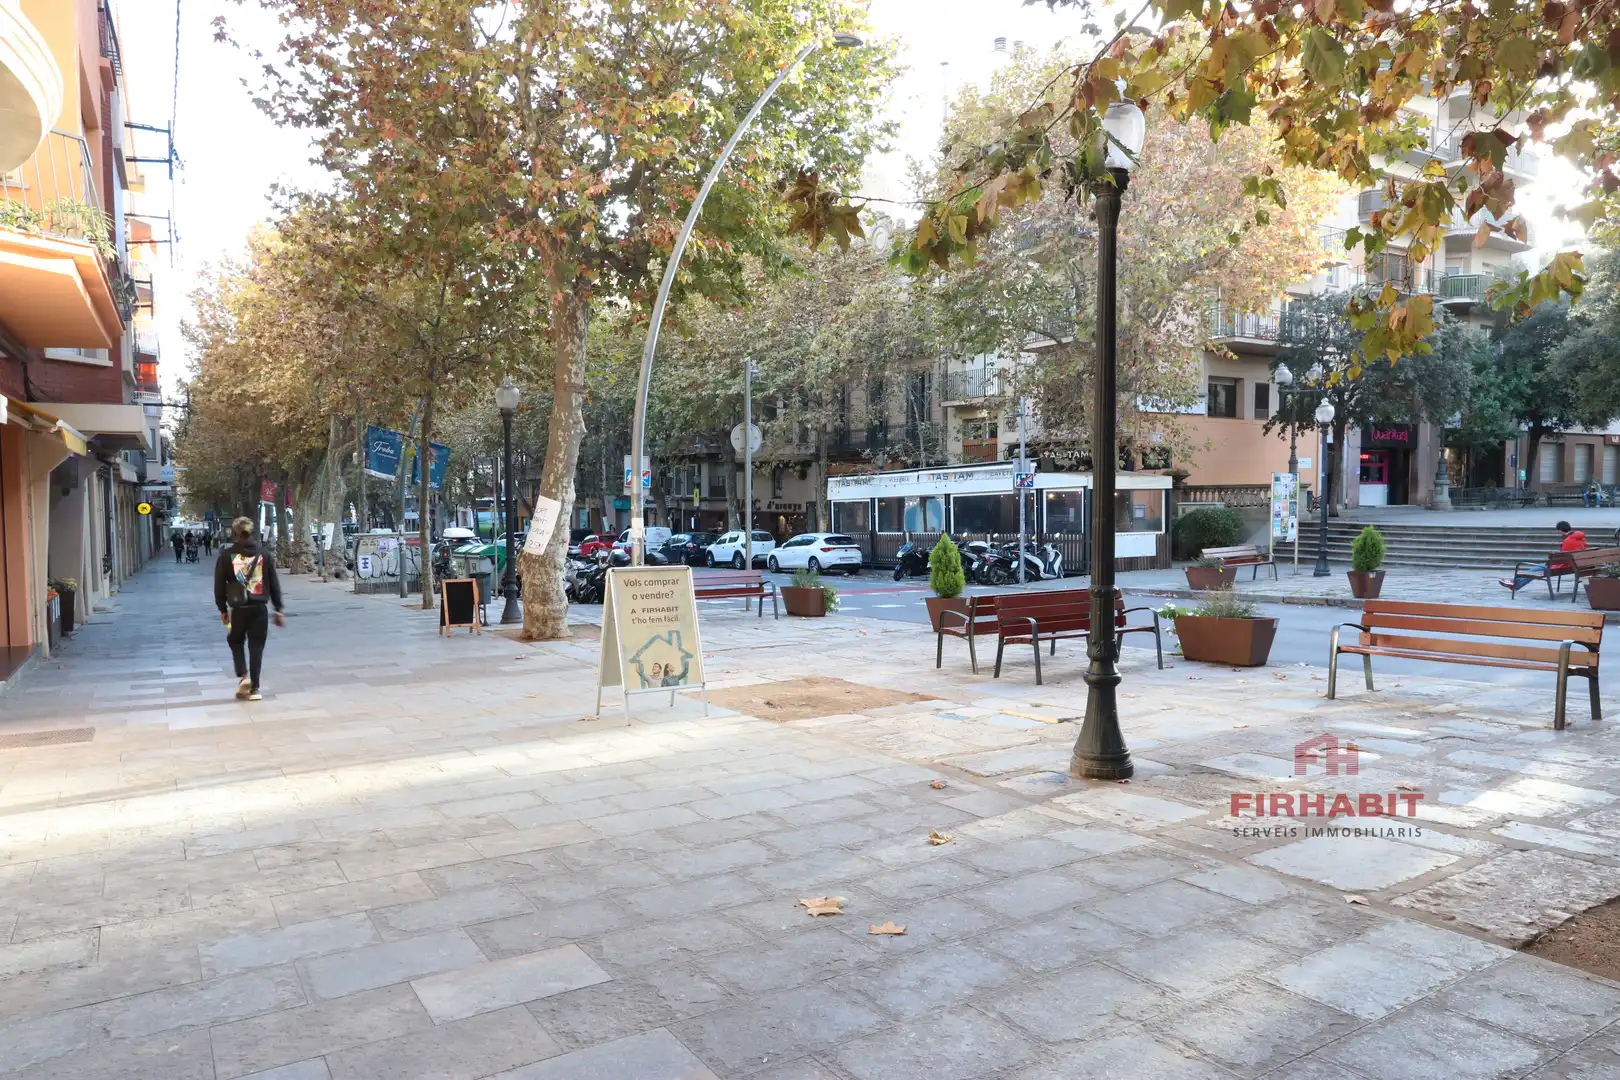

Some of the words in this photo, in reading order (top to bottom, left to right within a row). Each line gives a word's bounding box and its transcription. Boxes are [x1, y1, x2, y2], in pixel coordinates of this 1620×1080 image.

[623, 578, 642, 587] Vols
[644, 578, 680, 587] comprar
[640, 590, 675, 600] vendre?
[631, 617, 647, 625] t'ho
[648, 616, 663, 624] fem
